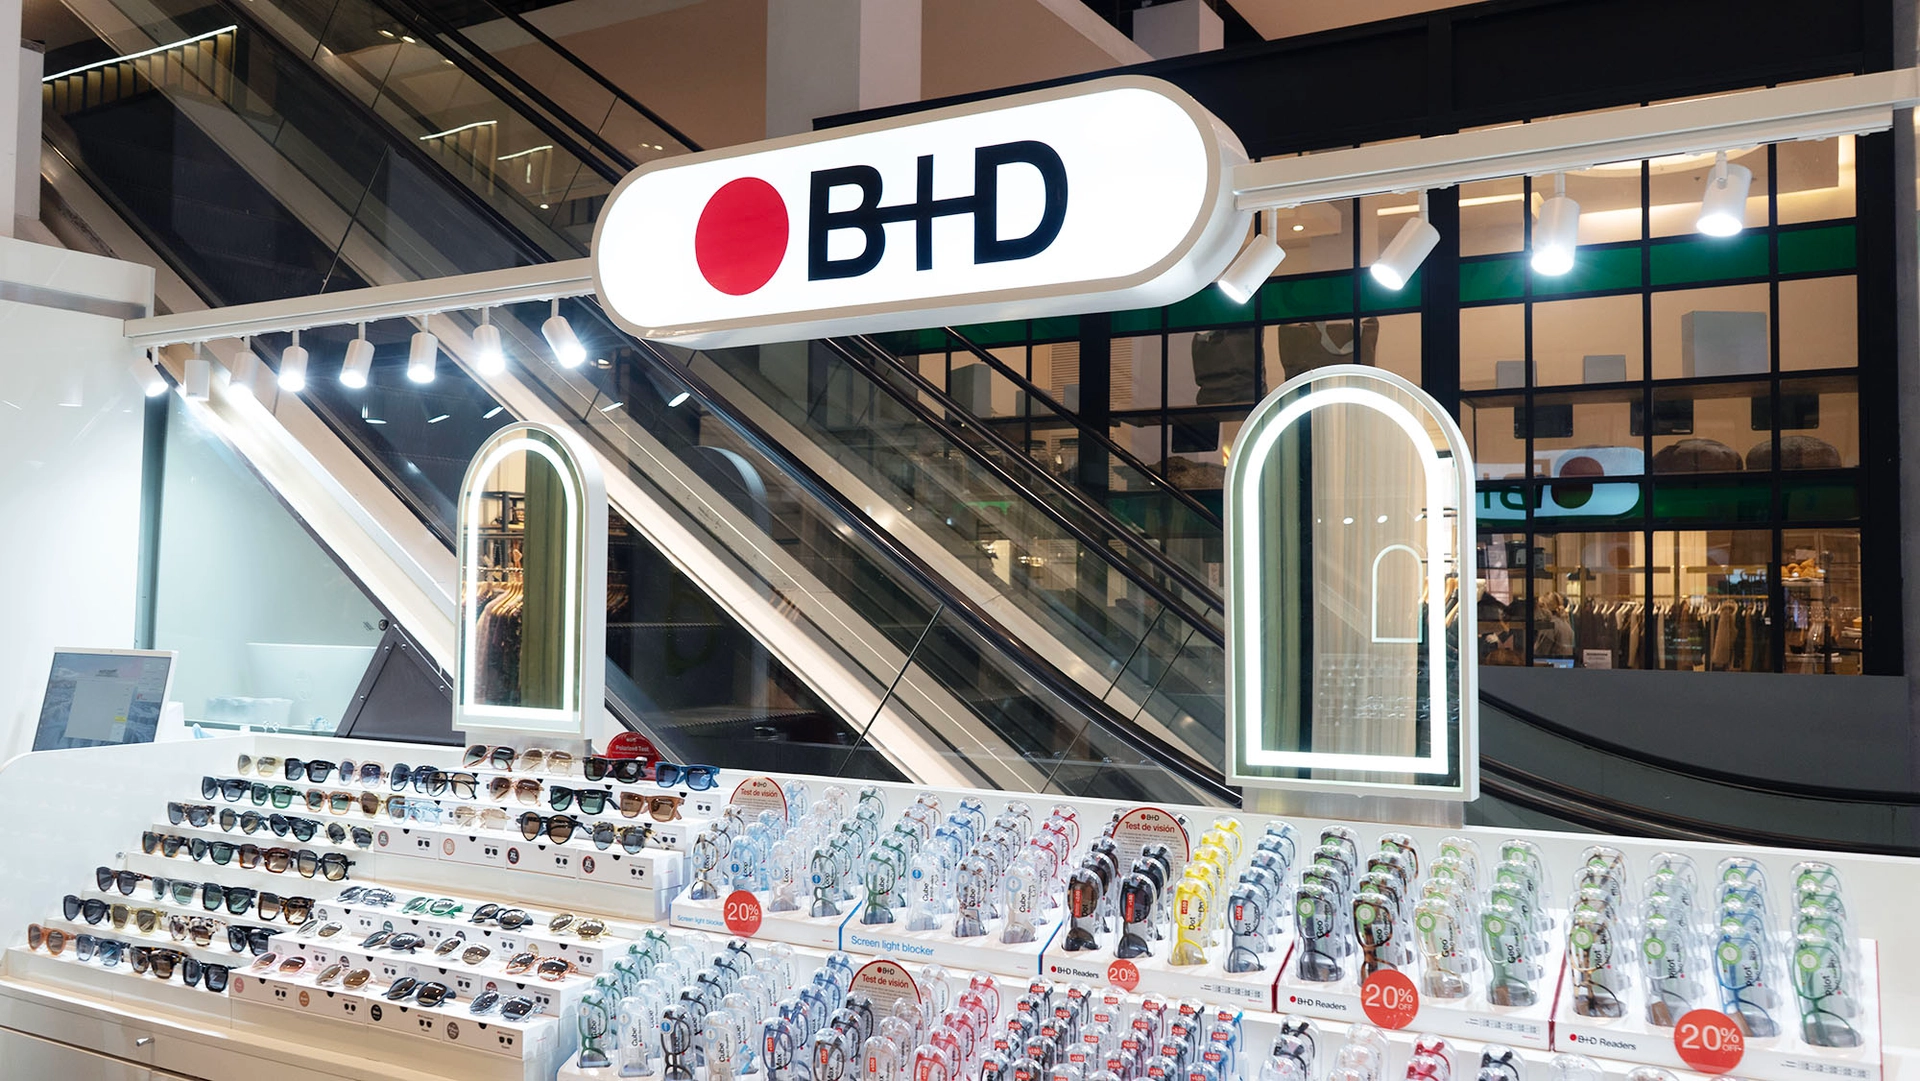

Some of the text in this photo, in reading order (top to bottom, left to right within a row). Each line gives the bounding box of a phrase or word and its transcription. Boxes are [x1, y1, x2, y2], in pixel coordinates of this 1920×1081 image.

[808, 140, 1068, 282] B+D
[1146, 813, 1160, 821] B+D
[1125, 821, 1175, 833] Test de visión
[727, 902, 759, 922] 20%
[677, 914, 724, 927] Screen light blocker
[1188, 917, 1196, 930] Dot
[1243, 922, 1251, 936] Dot
[1316, 921, 1324, 938] Geo
[850, 935, 935, 957] Screen light blocker
[1441, 939, 1449, 957] Geo
[1507, 944, 1516, 964] Geo
[1593, 950, 1603, 970] Pilot
[882, 967, 895, 975] B+D
[1057, 966, 1099, 979] B+D Readers
[1109, 967, 1136, 982] 20%
[1667, 959, 1677, 979] Pilot
[1744, 966, 1754, 987] Pilot
[862, 973, 909, 989] Test de visión
[1822, 975, 1834, 996] Pilot
[1297, 997, 1347, 1011] B+D Readers
[1365, 983, 1414, 1009] 20%
[1398, 1003, 1413, 1011] OFF
[1577, 1035, 1637, 1050] B+D Readers
[1680, 1023, 1740, 1051] 20%
[1722, 1044, 1740, 1052] OFF
